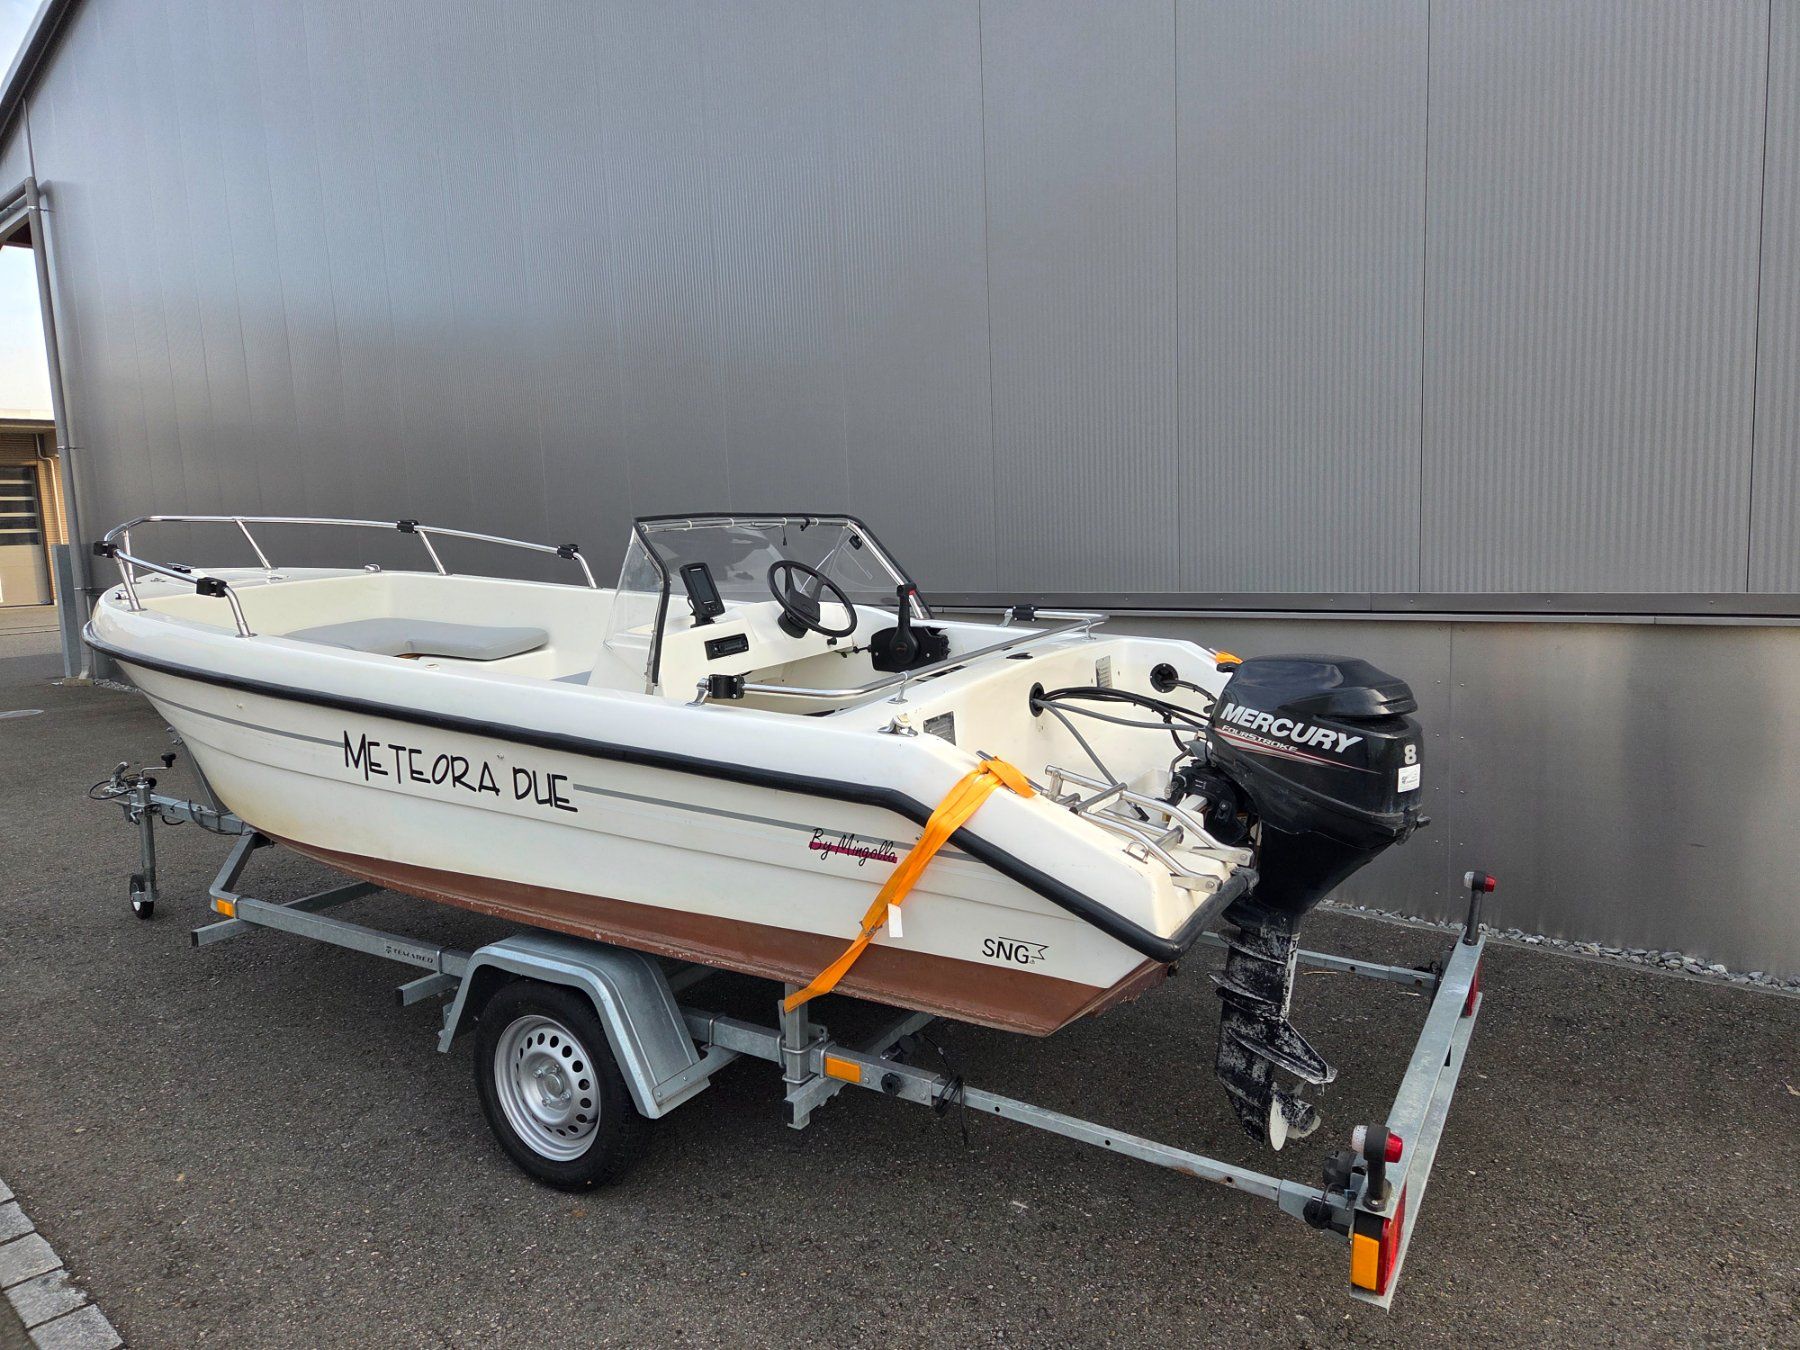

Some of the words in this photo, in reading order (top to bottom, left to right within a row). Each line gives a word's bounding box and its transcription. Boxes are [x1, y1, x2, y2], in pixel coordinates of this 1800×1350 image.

[1220, 702, 1363, 754] MERCURY
[1221, 724, 1299, 753] FOURSTROKE
[1404, 744, 1417, 765] 8
[343, 730, 501, 797] METEORA
[512, 766, 579, 813] DUE
[809, 827, 833, 861] By
[981, 938, 1030, 965] SNG
